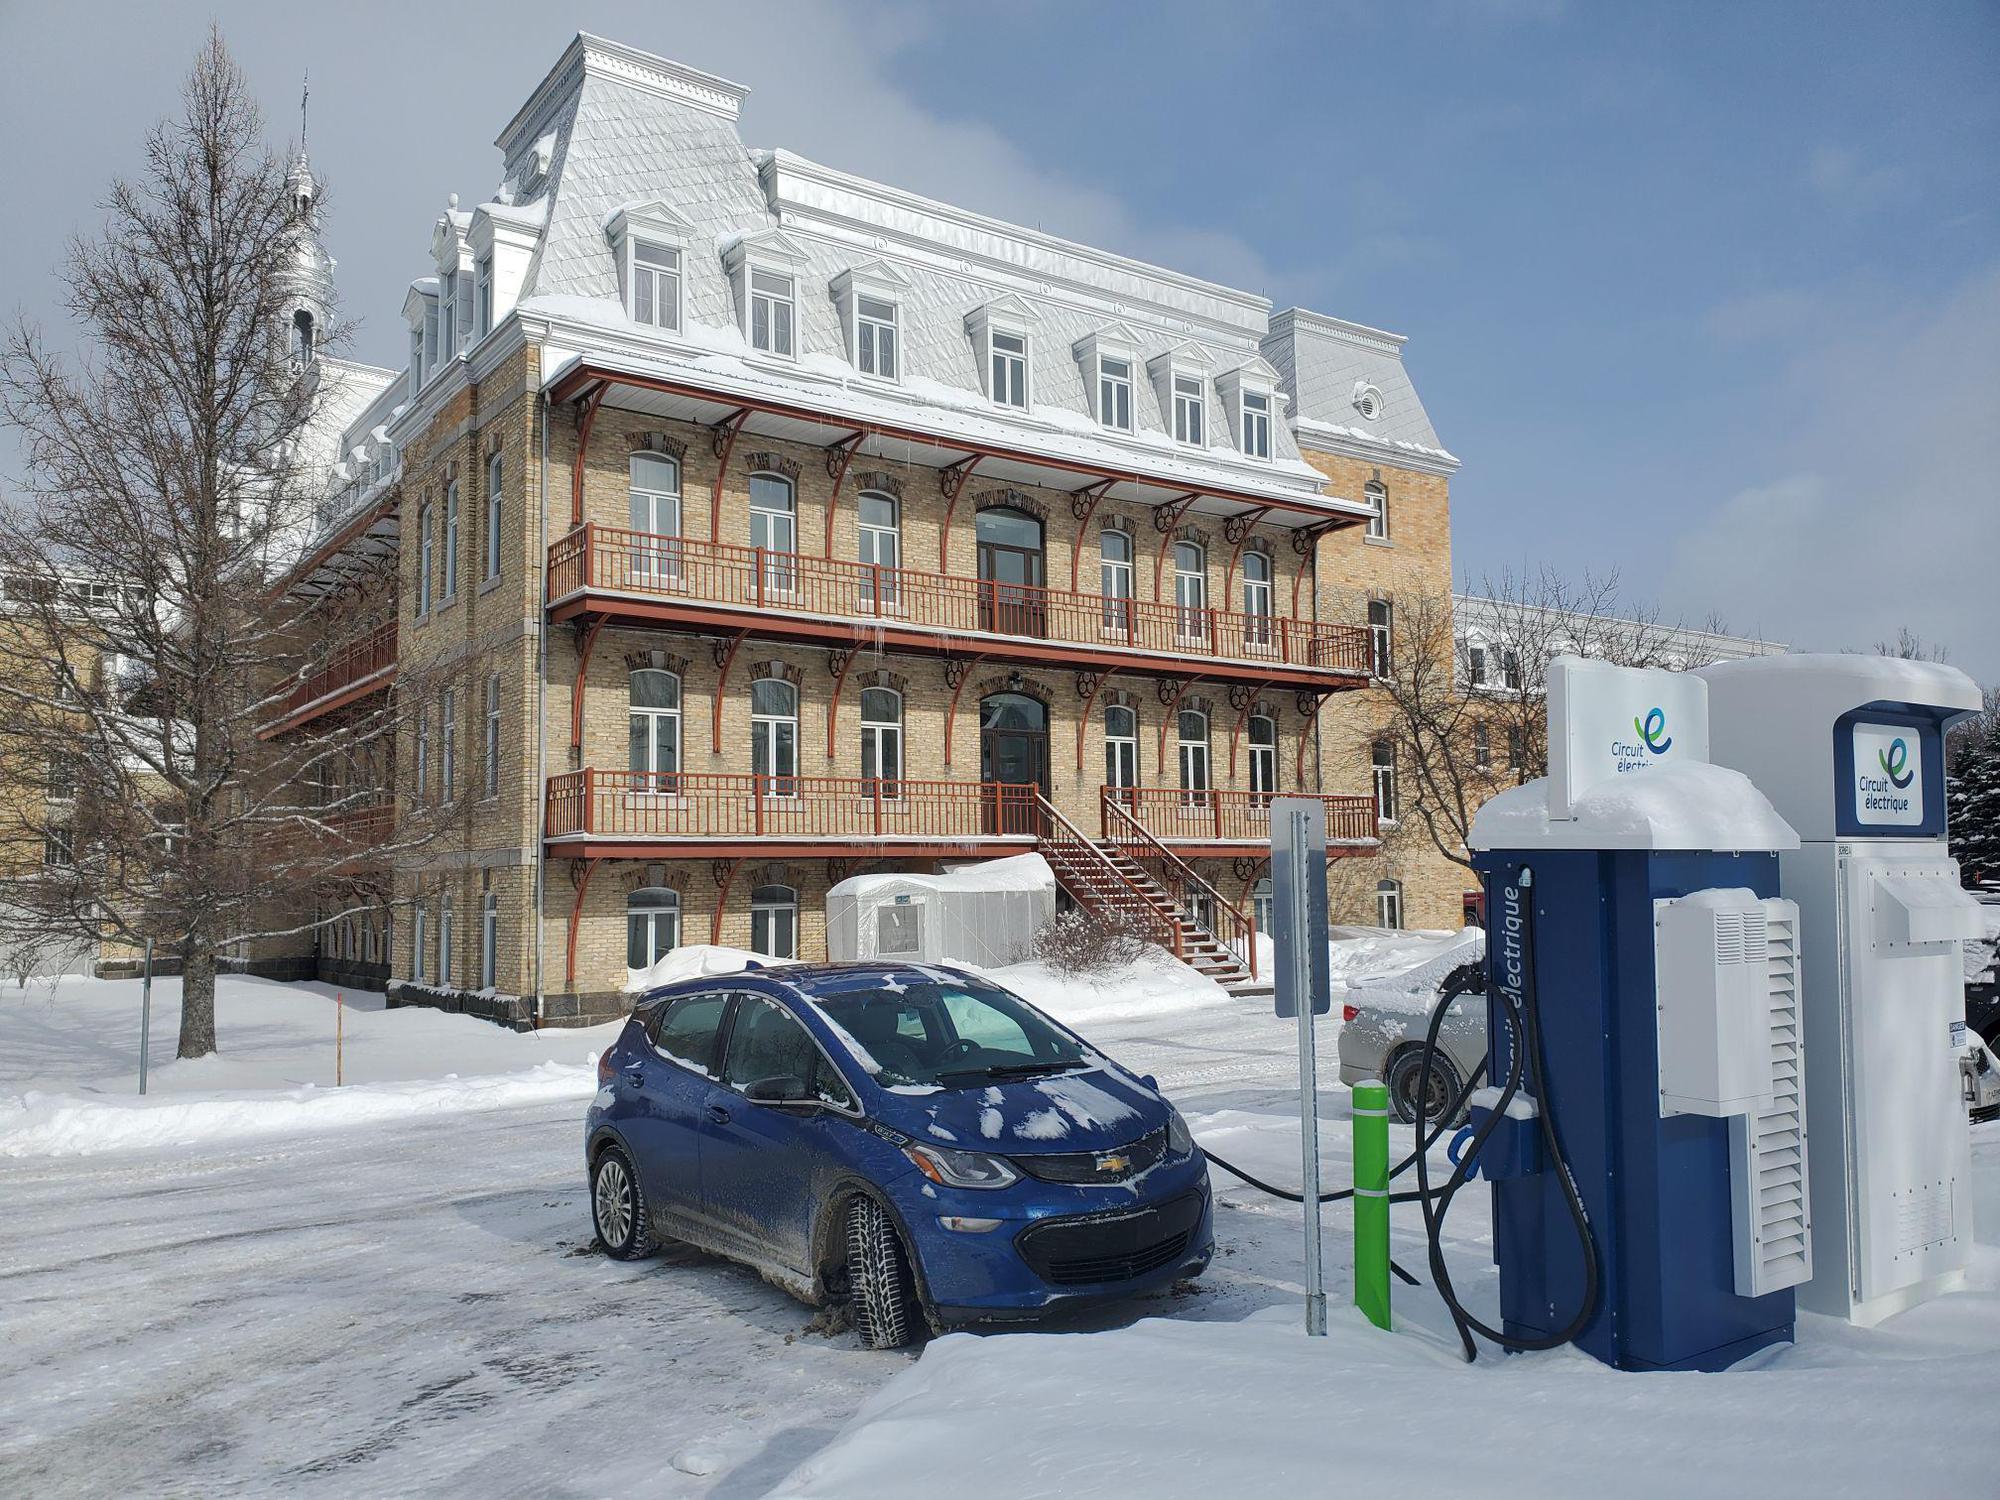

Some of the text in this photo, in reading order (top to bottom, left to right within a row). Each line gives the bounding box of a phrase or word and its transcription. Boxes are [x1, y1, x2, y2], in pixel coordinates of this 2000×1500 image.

[1611, 741, 1644, 757] Circuit
[1859, 775, 1889, 793] Circuit
[1865, 792, 1909, 813] électrique
[1499, 886, 1523, 1009] électrique
